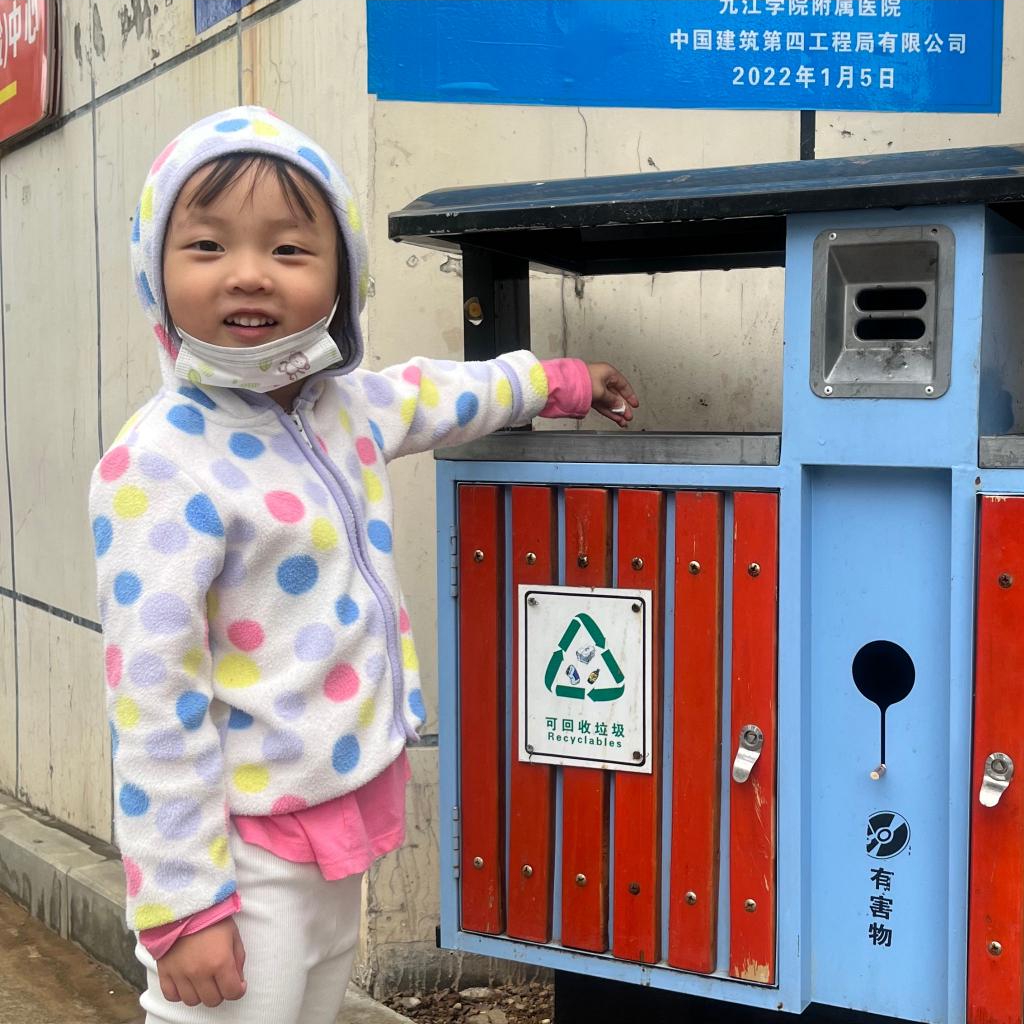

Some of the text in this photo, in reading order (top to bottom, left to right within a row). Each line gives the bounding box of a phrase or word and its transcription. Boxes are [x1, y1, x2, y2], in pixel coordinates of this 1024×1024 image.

[719, 0, 901, 17] 九江学院附属医院
[669, 28, 968, 54] 中国建筑第四工程局有限公司
[732, 65, 895, 89] 2022年1月5日
[545, 716, 625, 738] 可回收垃圾
[547, 732, 622, 748] Recyclables
[868, 867, 895, 947] 有害物
